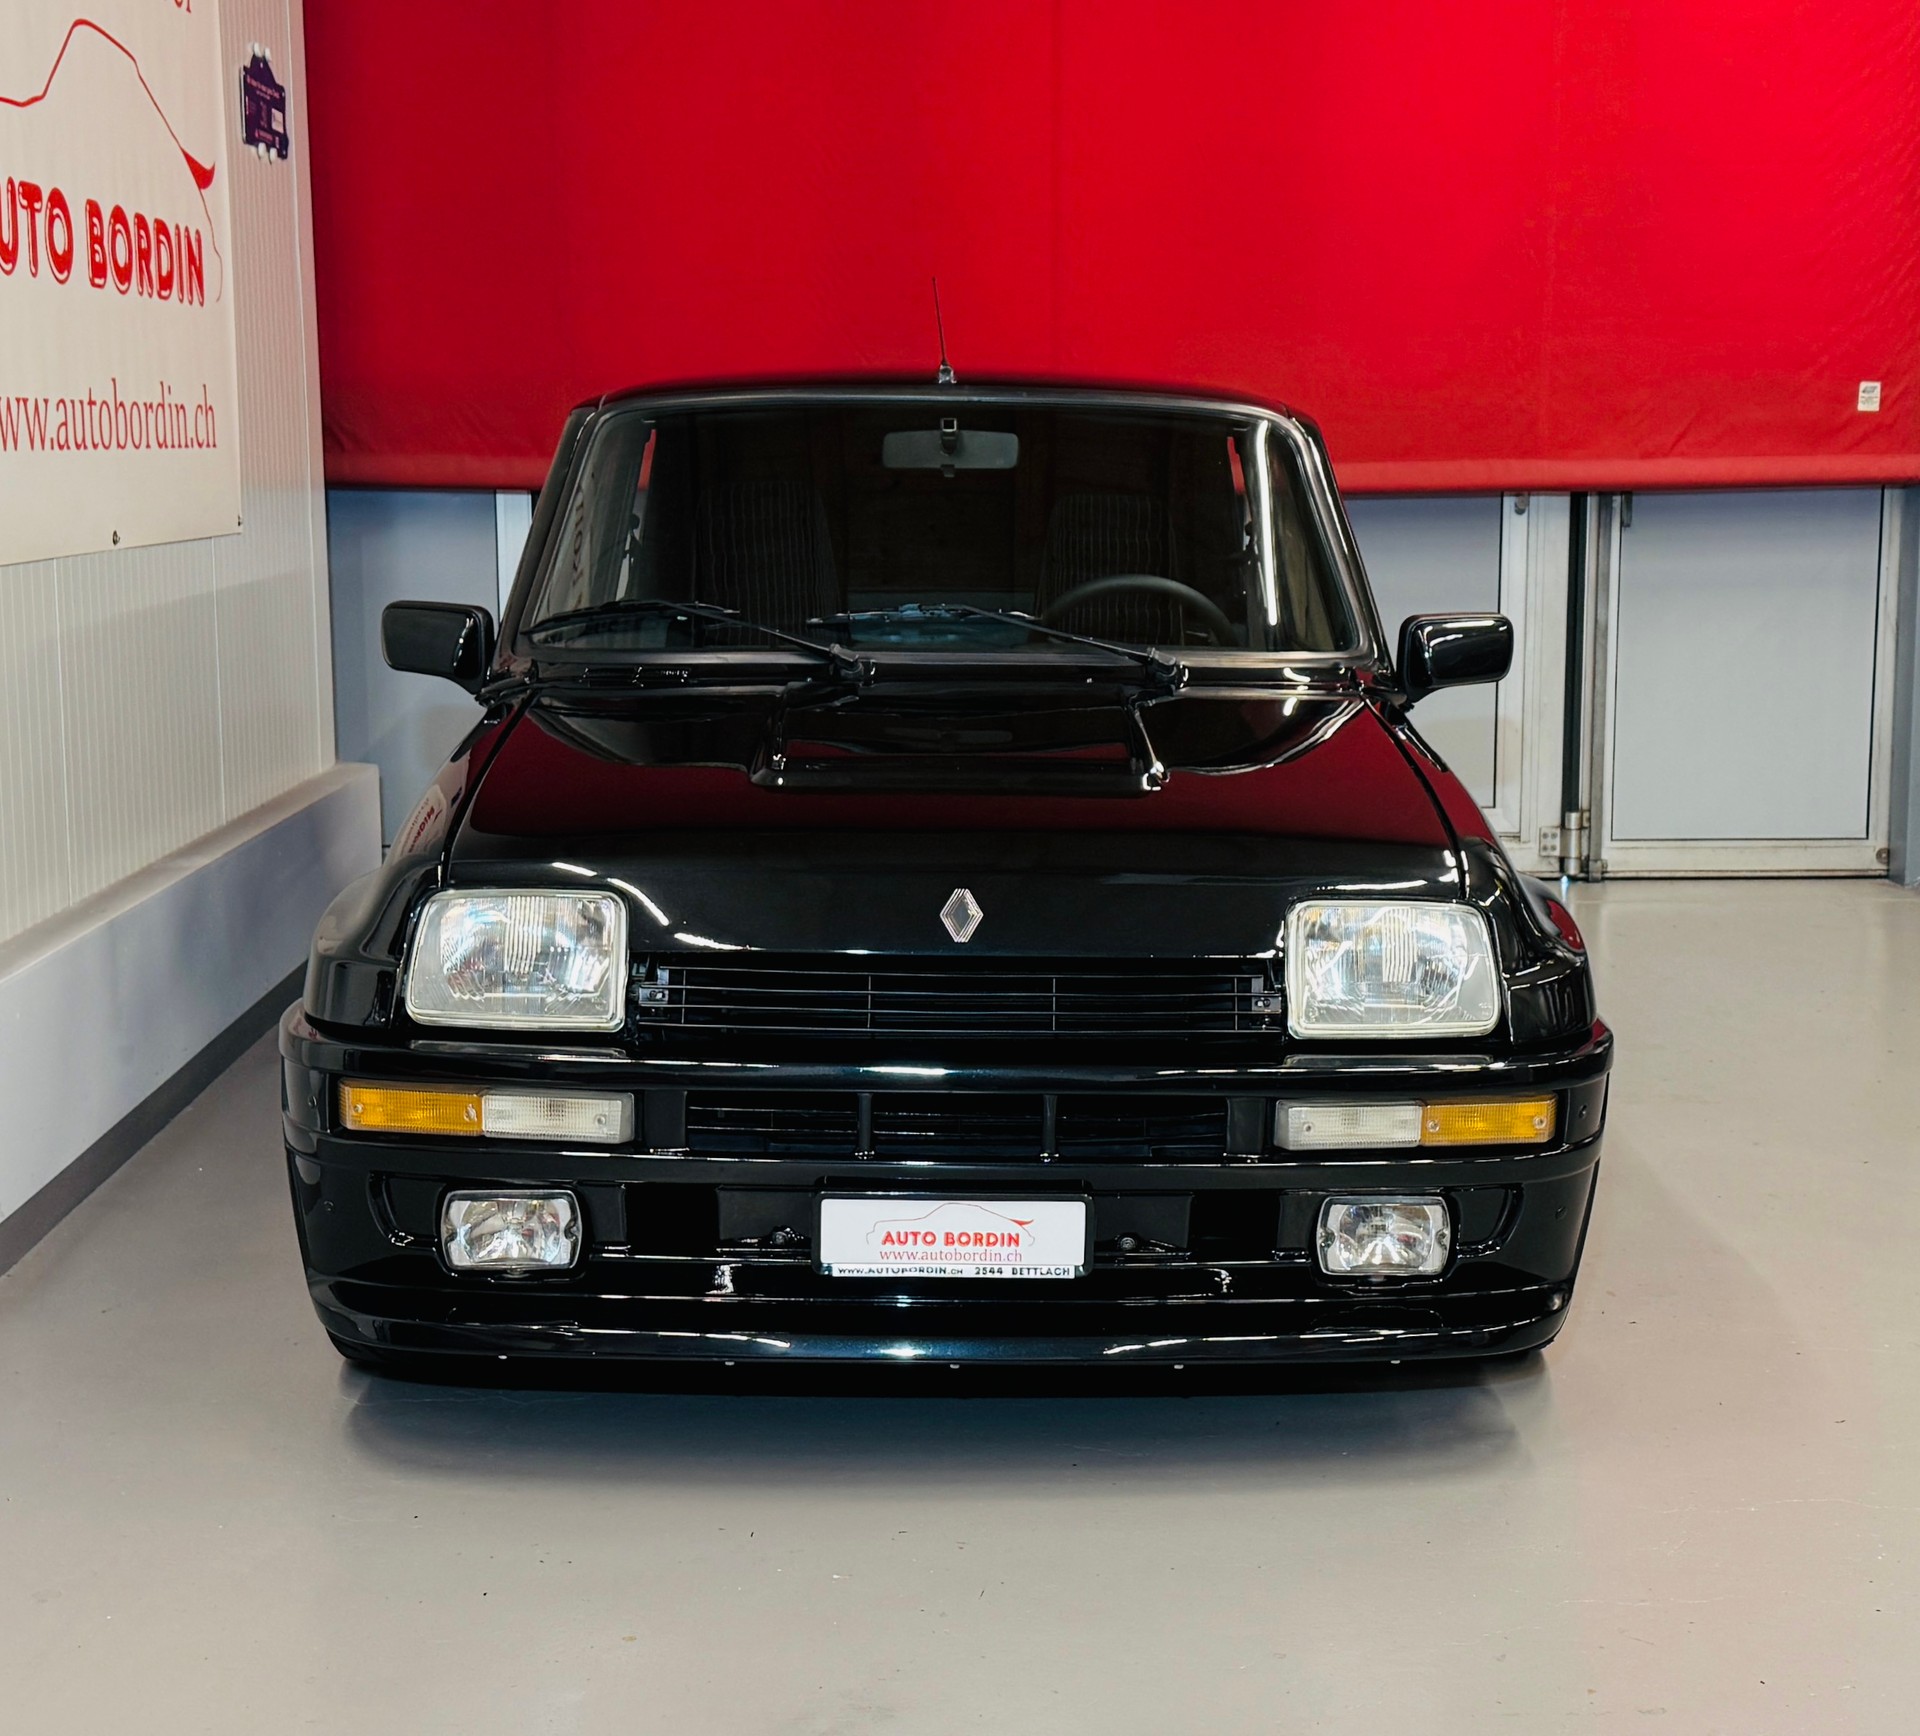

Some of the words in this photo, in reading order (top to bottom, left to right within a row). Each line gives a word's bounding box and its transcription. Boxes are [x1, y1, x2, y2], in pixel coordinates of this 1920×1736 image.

[85, 198, 204, 307] BORDIN
[881, 1231, 937, 1246] AUTO
[943, 1231, 1020, 1247] BORDIN
[879, 1248, 1023, 1262] www.autobordin.ch
[974, 1266, 1003, 1275] 2544
[1011, 1267, 1070, 1276] BETTLACH
